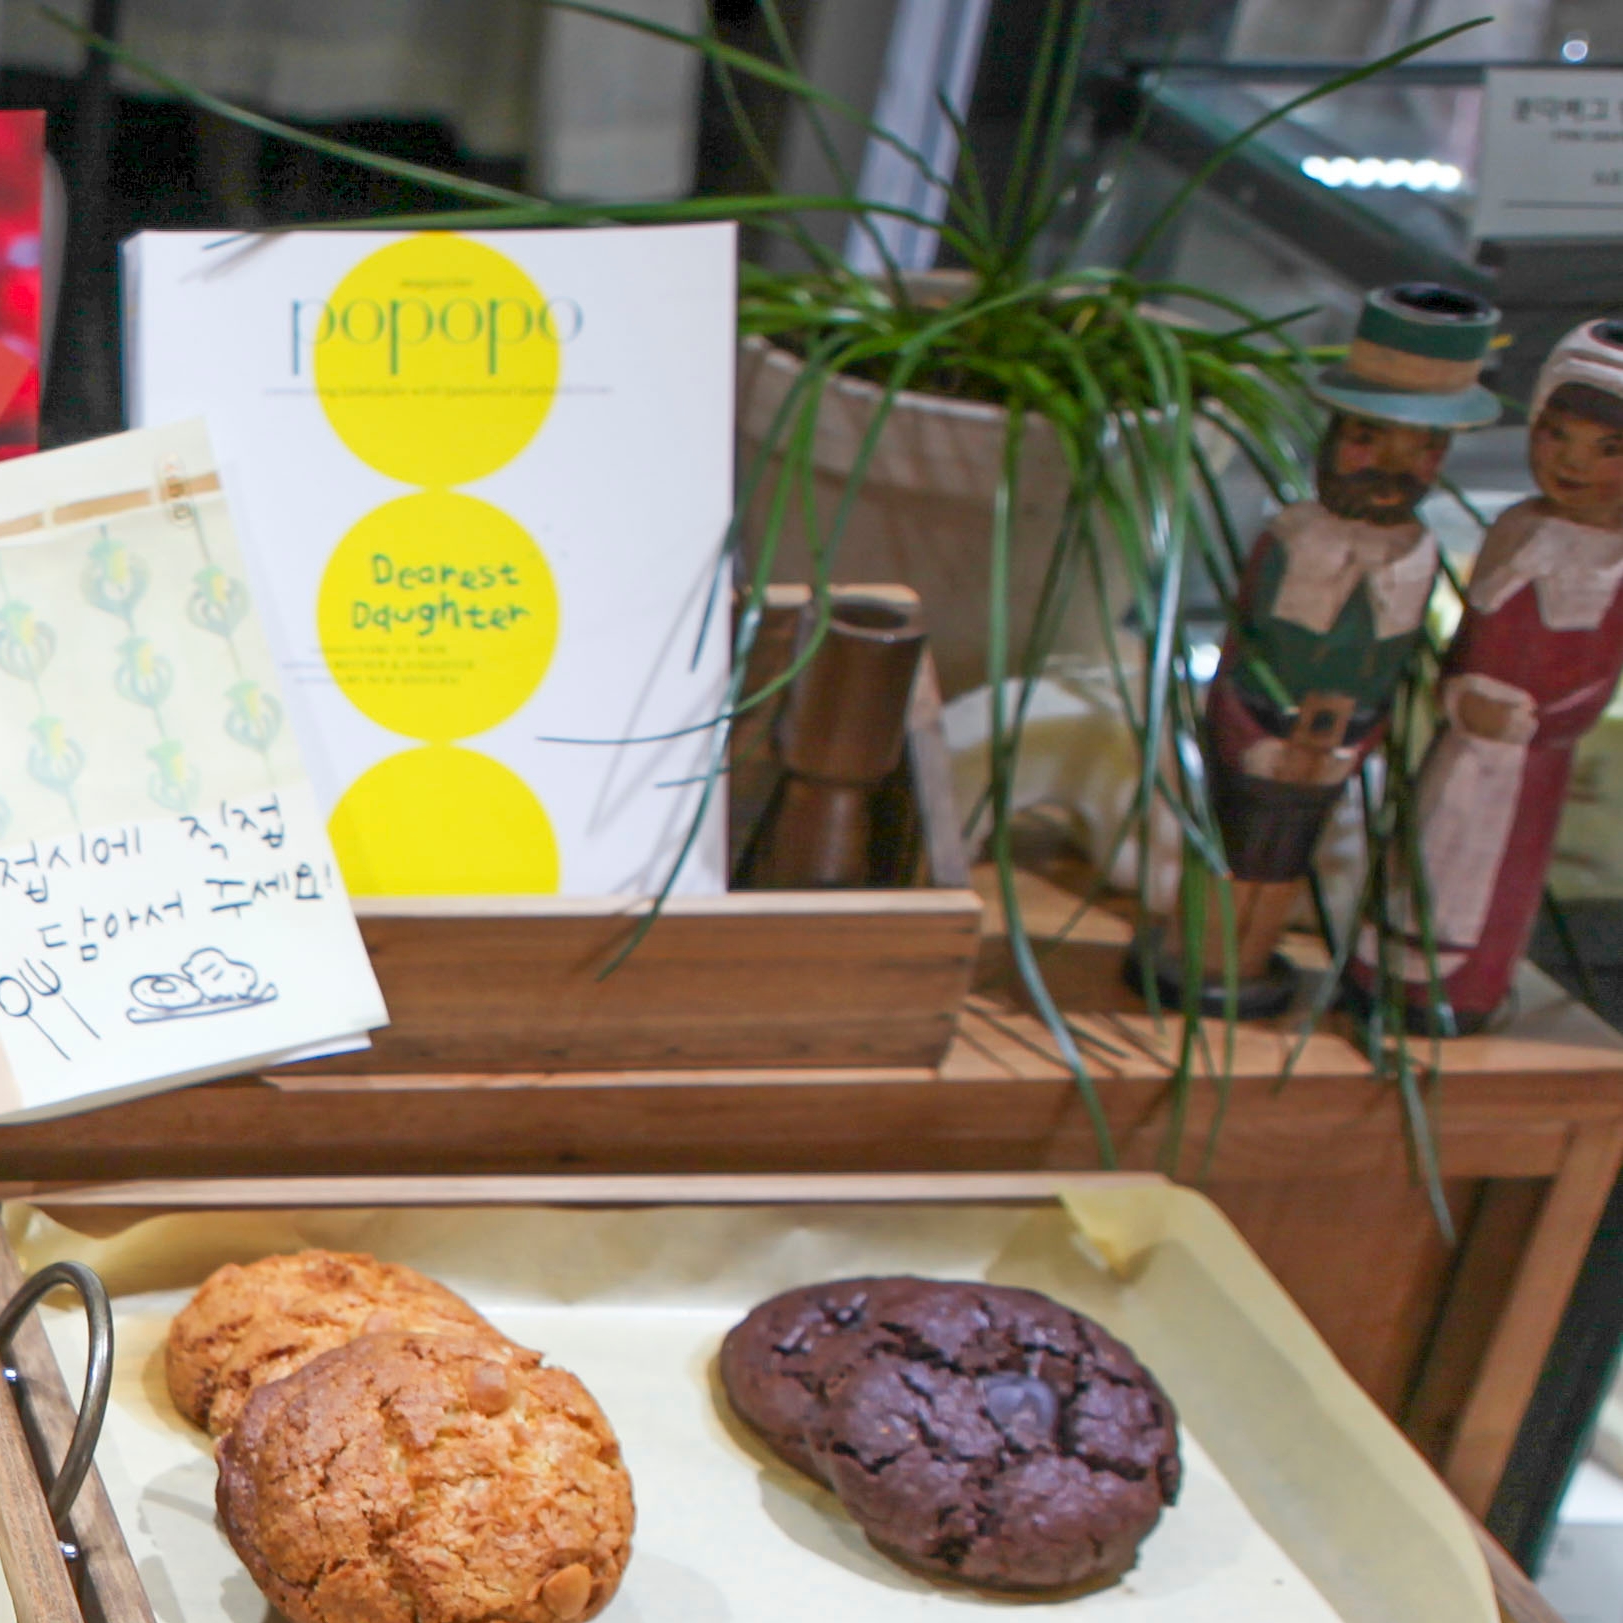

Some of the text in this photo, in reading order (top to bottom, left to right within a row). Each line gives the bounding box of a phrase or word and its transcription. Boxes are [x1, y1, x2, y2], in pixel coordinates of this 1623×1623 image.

[291, 297, 584, 375] popopo
[371, 553, 520, 590] Dearest
[351, 592, 531, 637] Daughter
[178, 793, 286, 860] 직접
[37, 891, 184, 962] 담아서
